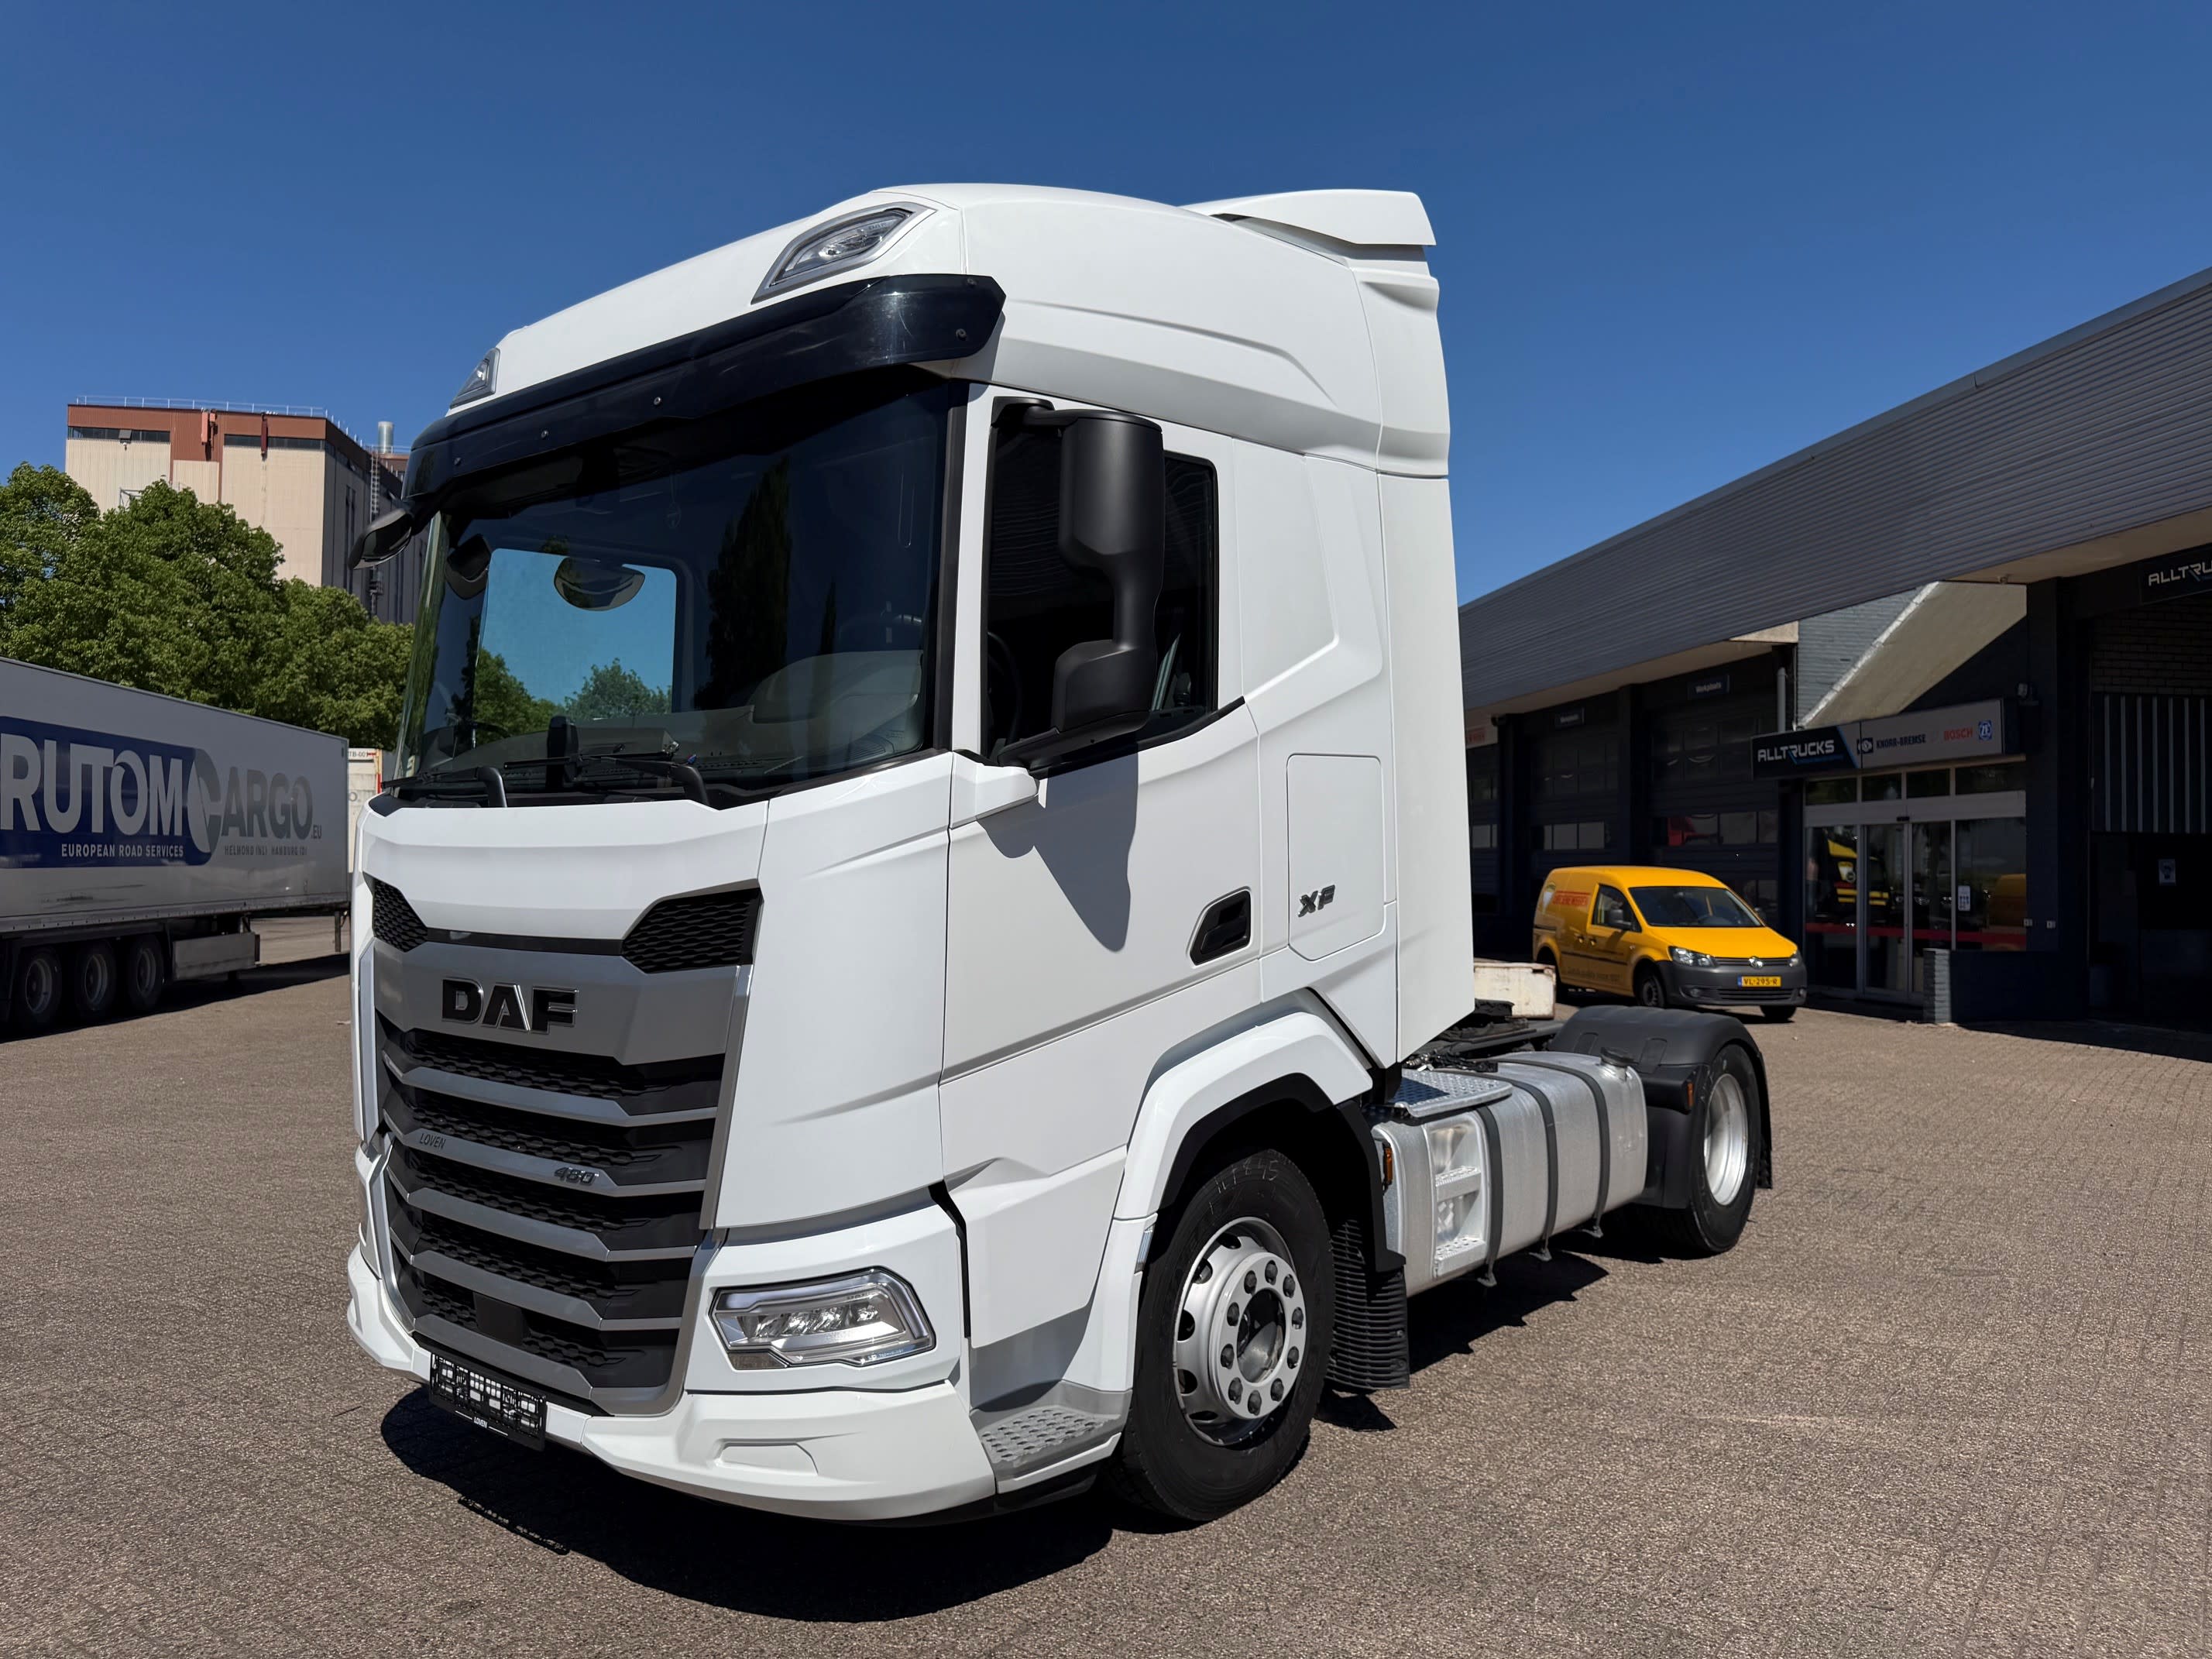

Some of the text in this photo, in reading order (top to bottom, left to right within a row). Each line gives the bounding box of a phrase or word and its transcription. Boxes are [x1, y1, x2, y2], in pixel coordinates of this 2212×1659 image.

[1757, 739, 1836, 763] ALLTRUCKS
[1876, 733, 1926, 749] KNORR-BREMSE
[1943, 727, 1973, 740] BOSCH
[61, 843, 184, 857] EUROPEAN ROAD SERVICES
[225, 845, 254, 856] HELMOND
[1297, 884, 1336, 918] XF
[441, 977, 579, 1035] DAF
[420, 1133, 447, 1149] LOVEN
[473, 1416, 488, 1429] LOVEN
